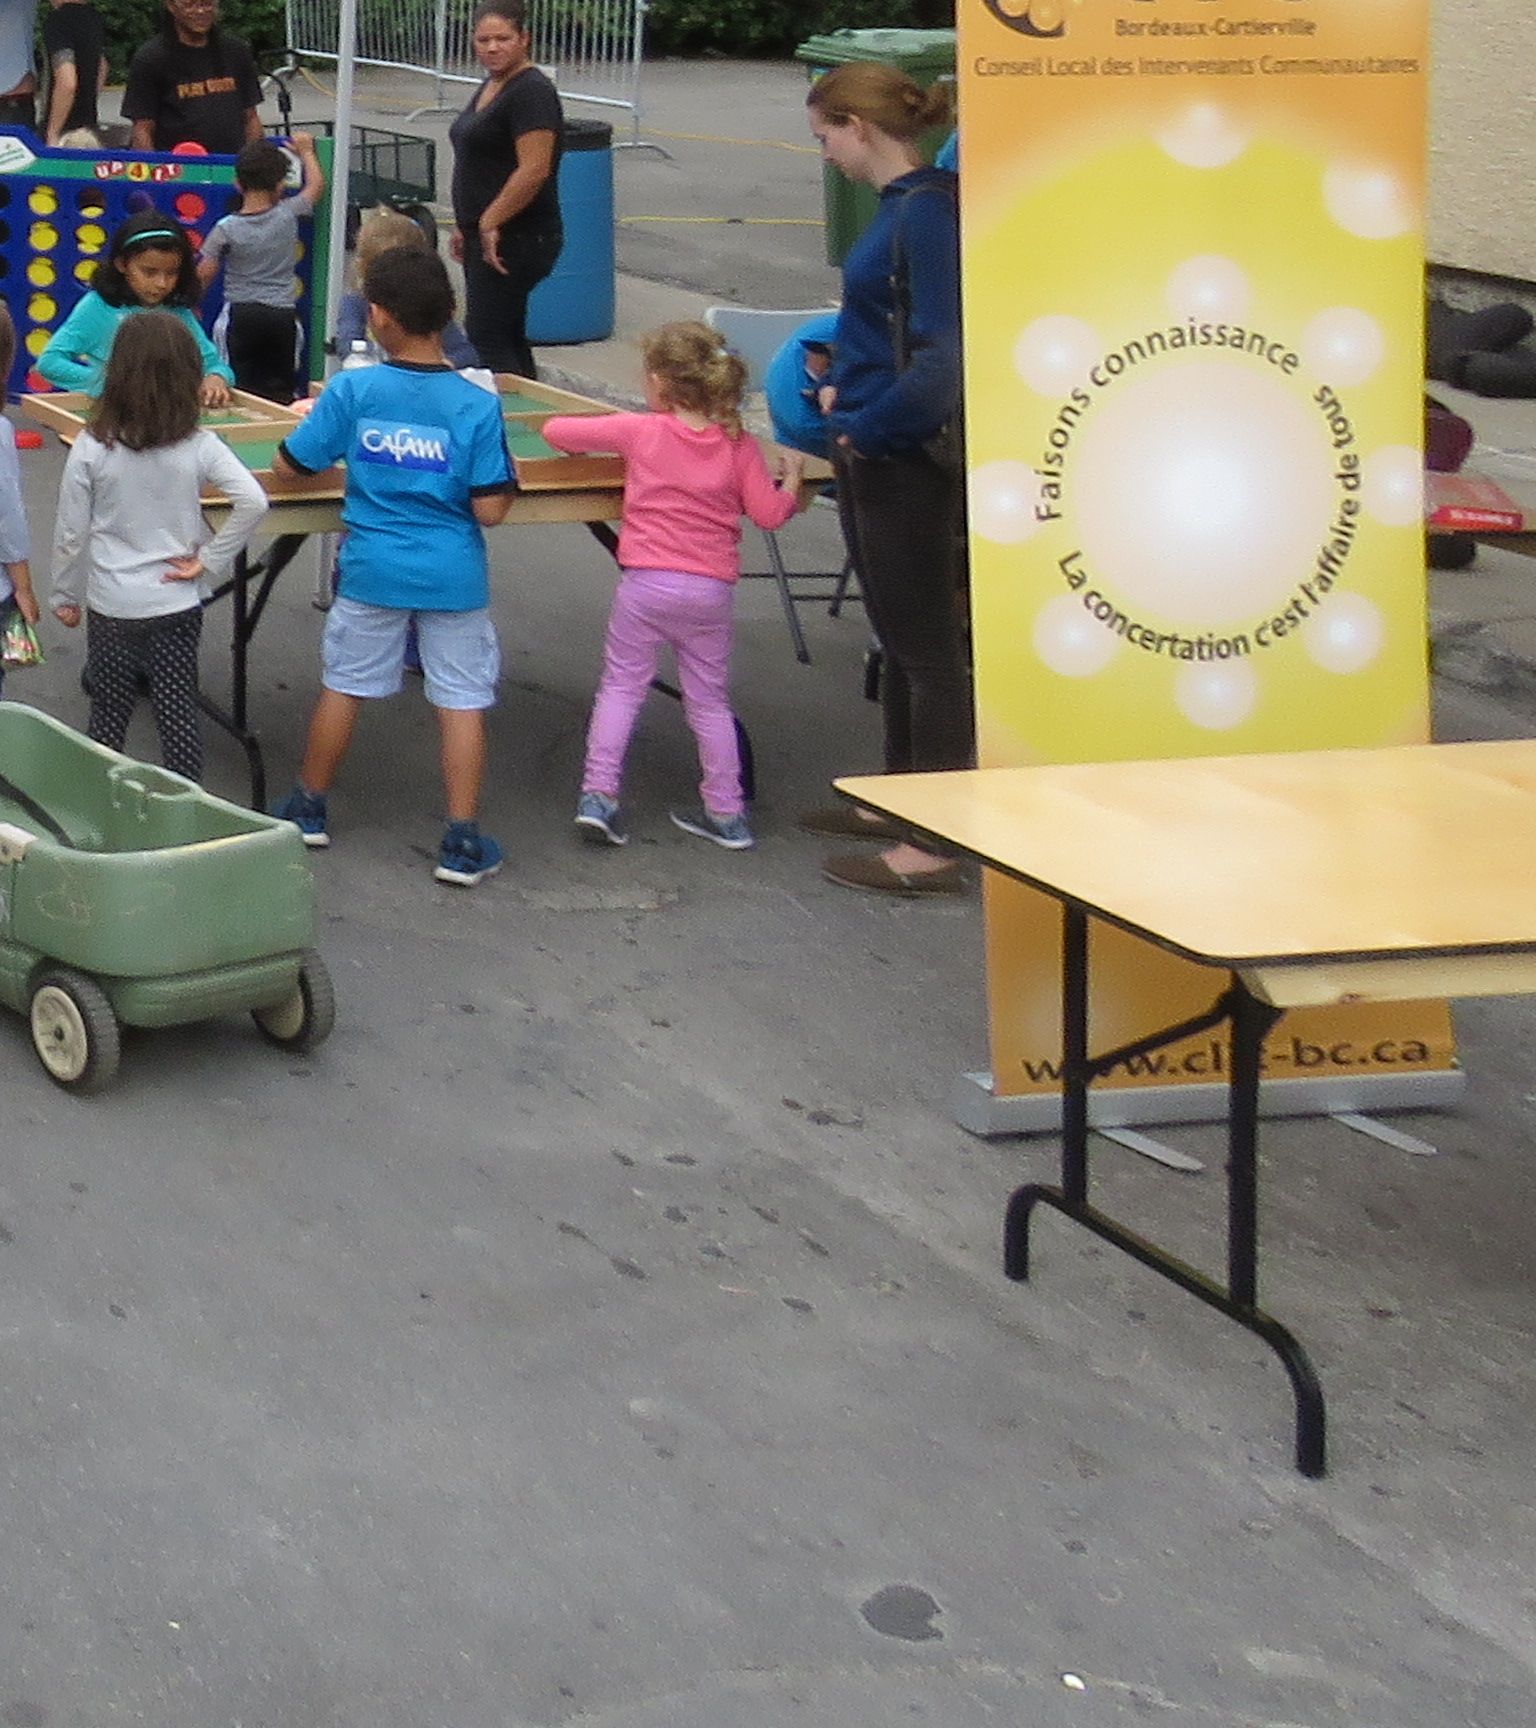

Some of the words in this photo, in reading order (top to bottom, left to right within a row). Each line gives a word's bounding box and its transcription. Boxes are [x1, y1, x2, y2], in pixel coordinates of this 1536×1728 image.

[1114, 17, 1317, 37] Bordeaux-Cartierville
[974, 56, 1043, 77] Conseil
[1047, 56, 1097, 77] Local
[1100, 57, 1134, 76] des
[1260, 54, 1420, 75] Communautaires
[1035, 386, 1090, 522] Faisons
[1089, 317, 1302, 388] connaissance
[1312, 384, 1356, 450] tous
[1338, 452, 1361, 493] de
[1058, 550, 1088, 590] La
[1082, 589, 1251, 661] concertation
[1021, 1036, 1428, 1084] ww.cl-bc.ca
